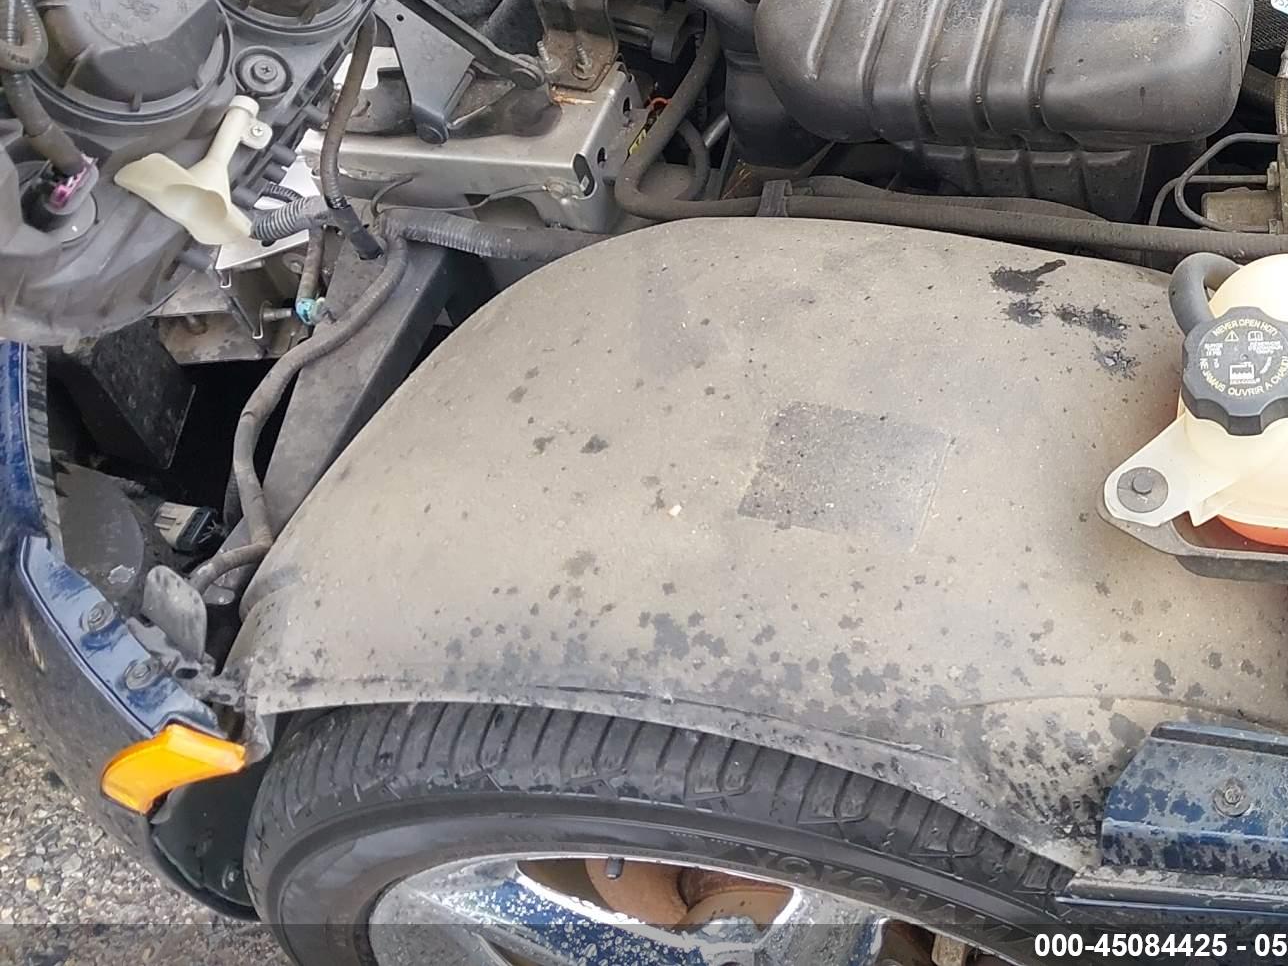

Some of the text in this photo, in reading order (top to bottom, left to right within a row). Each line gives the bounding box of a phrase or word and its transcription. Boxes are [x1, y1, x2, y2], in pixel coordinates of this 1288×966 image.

[1211, 319, 1238, 336] NEVER
[1238, 318, 1262, 329] OPEN
[1227, 385, 1264, 396] OUVRIR
